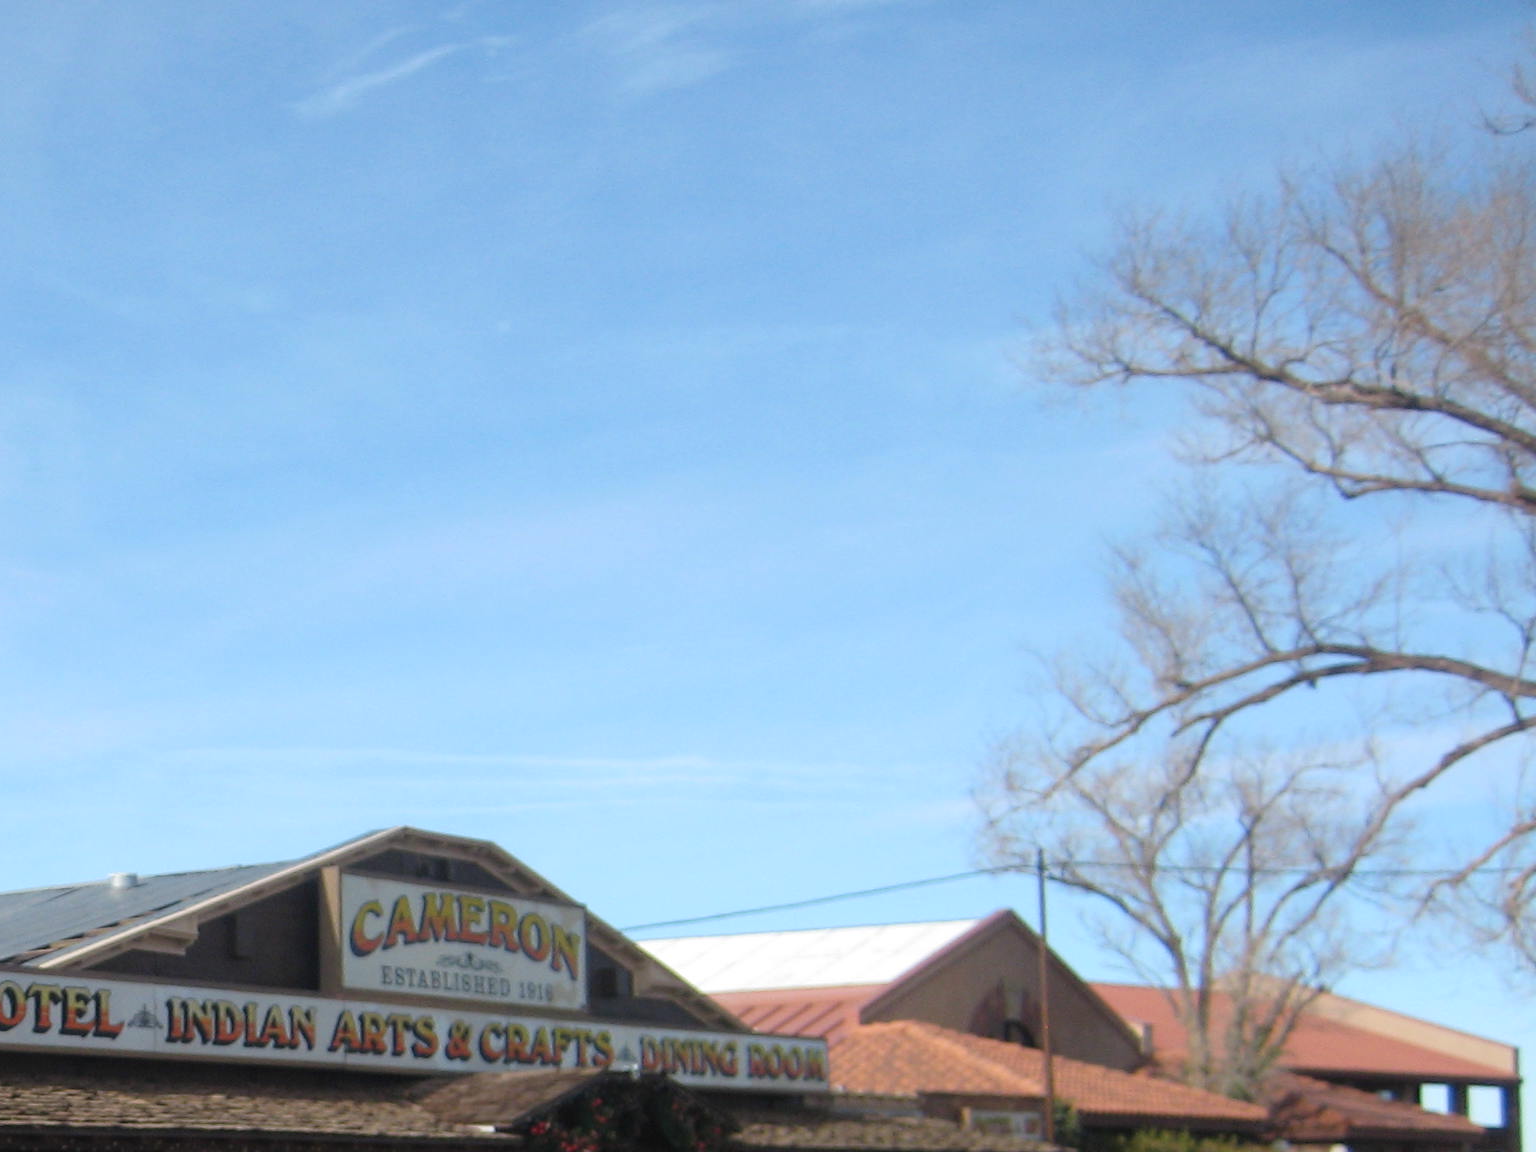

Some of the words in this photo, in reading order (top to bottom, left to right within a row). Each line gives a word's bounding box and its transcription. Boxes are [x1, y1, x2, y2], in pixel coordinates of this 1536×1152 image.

[350, 892, 580, 981] CAMERON
[381, 964, 511, 997] ESTABLISHED
[166, 996, 316, 1051] INDIAN
[328, 1010, 439, 1060] ARTS
[445, 1019, 473, 1062] &
[480, 1022, 615, 1068] CRAFTS
[639, 1033, 738, 1077] DINING
[748, 1043, 826, 1082] ROOM
